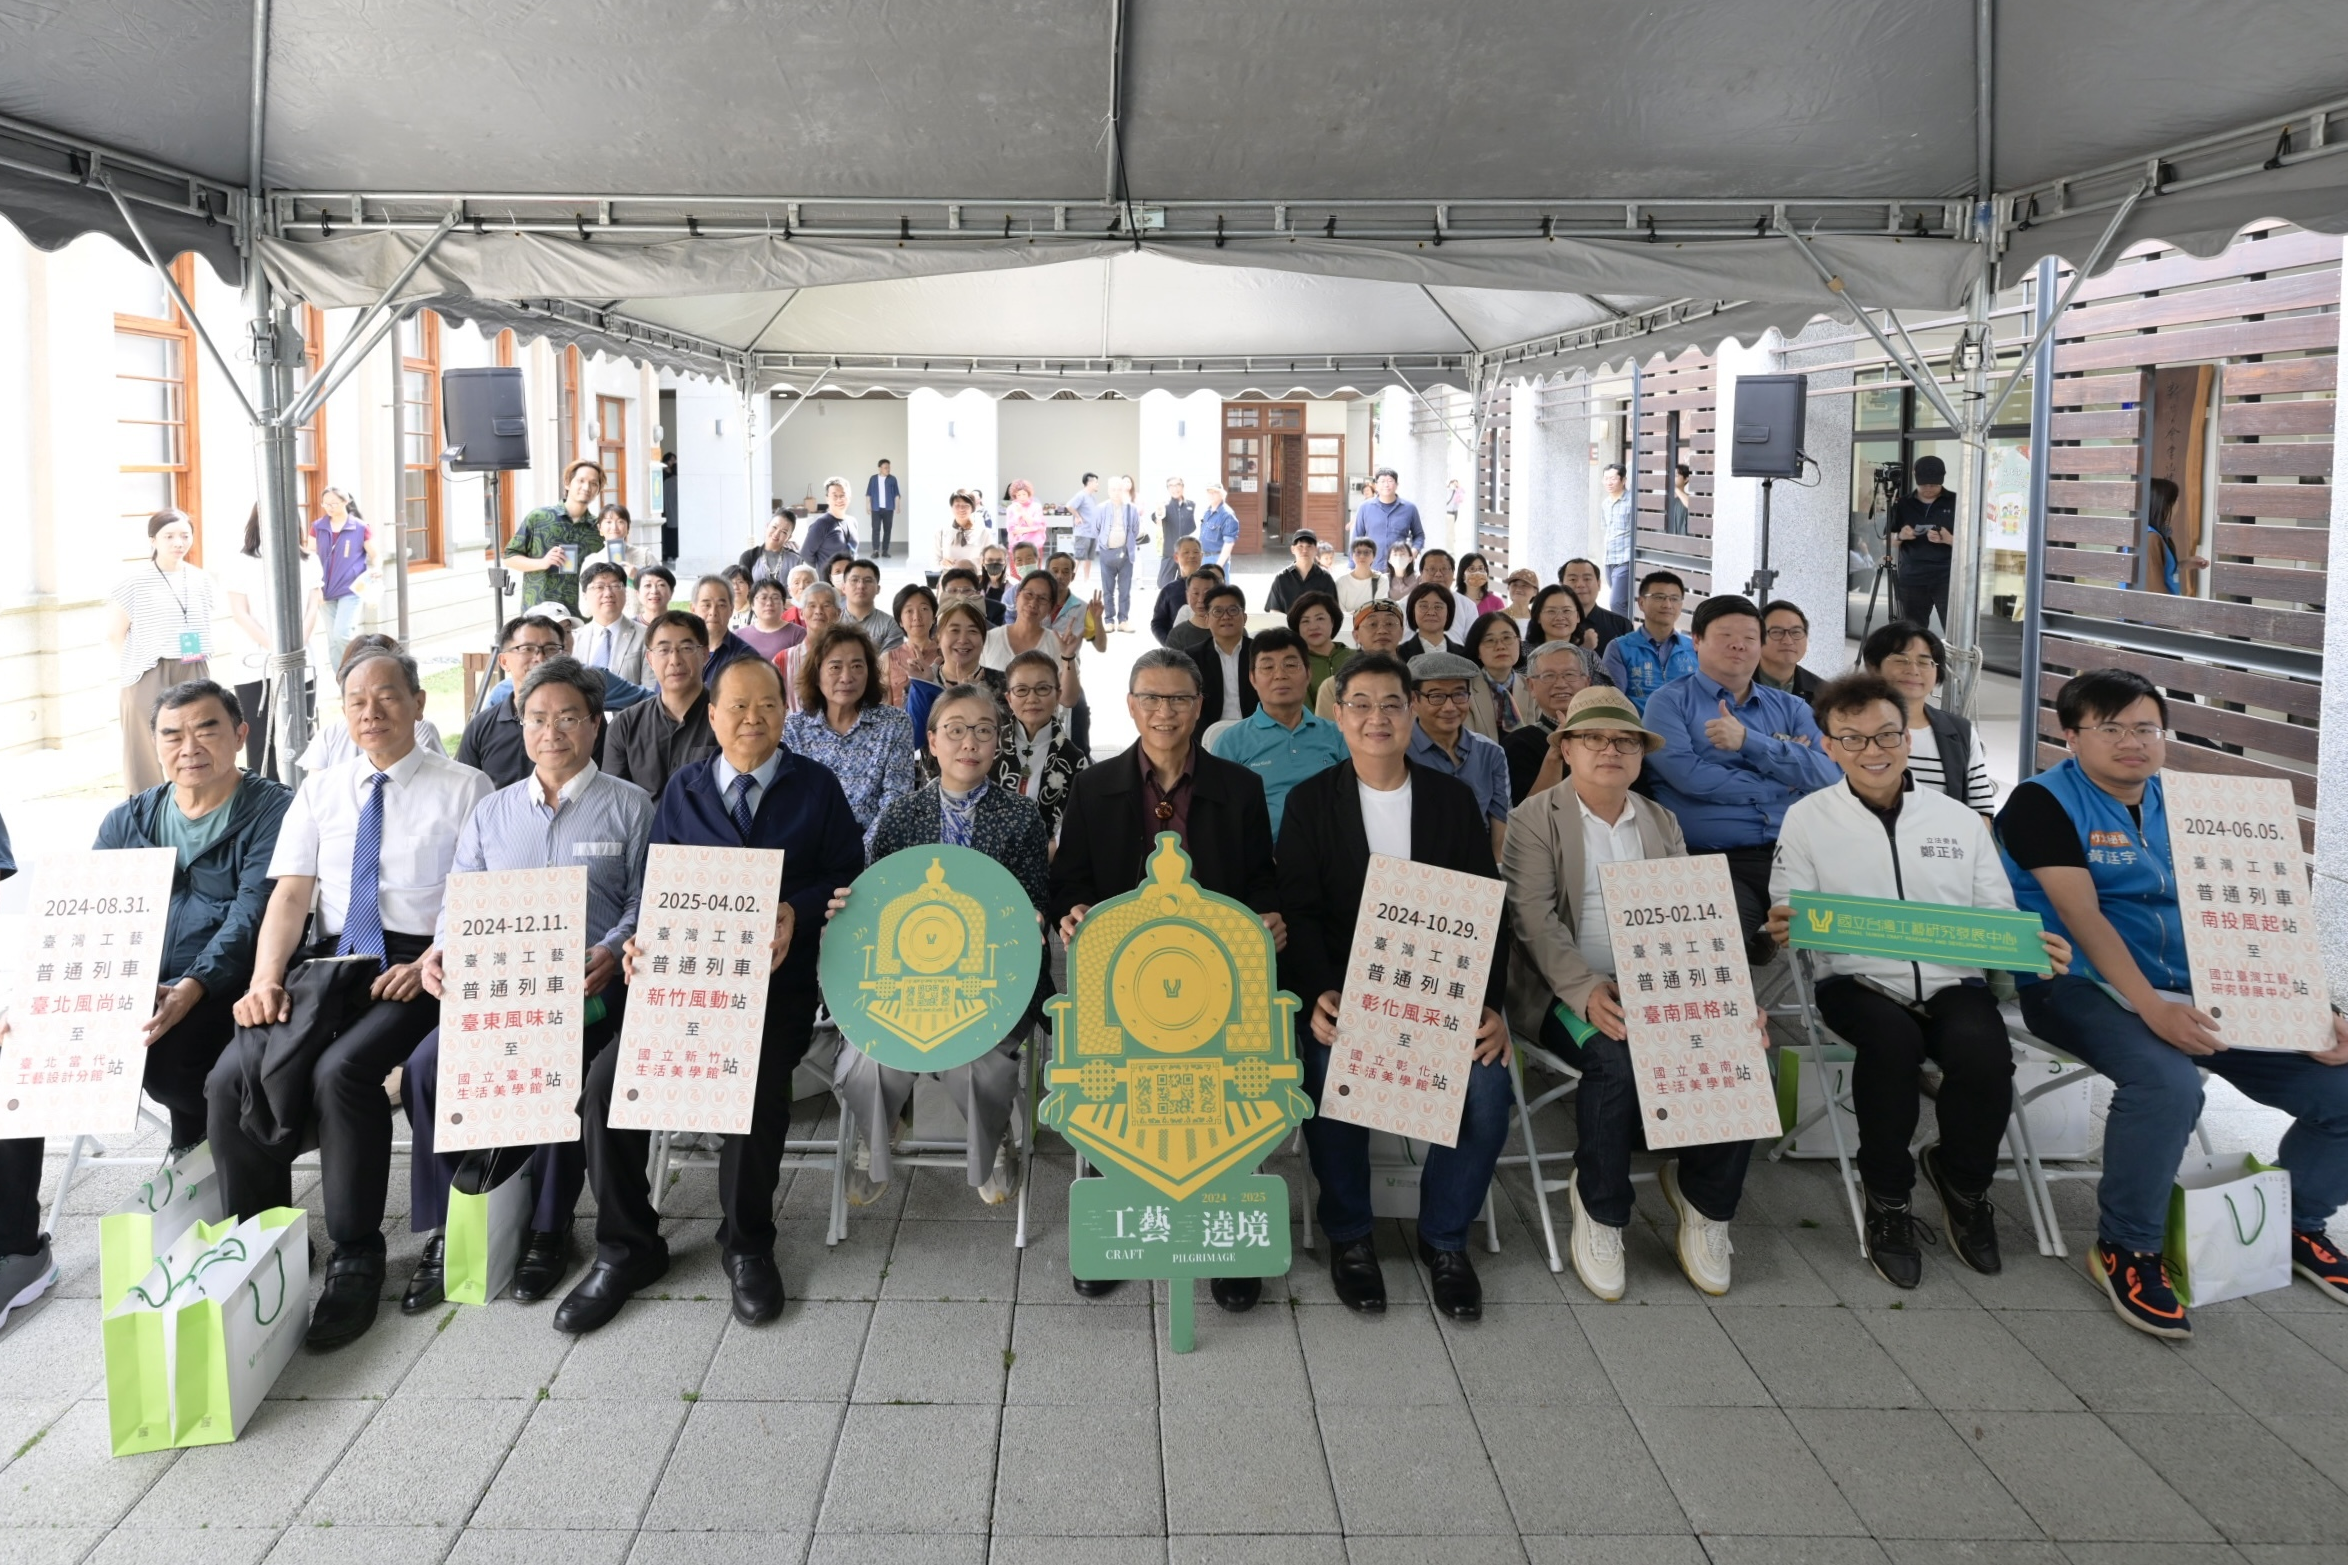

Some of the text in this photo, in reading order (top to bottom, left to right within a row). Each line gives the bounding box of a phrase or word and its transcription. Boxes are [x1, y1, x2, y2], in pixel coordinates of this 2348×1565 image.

[2185, 818, 2284, 841] 2024-06.05.
[658, 892, 761, 913] 2025-04.02.
[2197, 883, 2293, 906] 普通列車
[44, 896, 150, 917] 2024-08.31.
[1623, 904, 1723, 927] 2025-02.14.
[462, 914, 568, 936] 2024-12.11.
[1377, 903, 1478, 940] 2024-10.29.
[42, 931, 143, 949] 臺灣工藝
[657, 926, 755, 944] 臺灣工藝
[464, 948, 565, 968] 臺灣工藝
[1374, 936, 1472, 970] 臺灣工藝
[1633, 938, 1725, 959] 臺灣工藝
[2247, 944, 2261, 957] 至
[36, 959, 139, 982] 普通列車
[651, 955, 752, 977] 普通列車
[462, 975, 565, 1000] 普通列車
[1368, 963, 1466, 1000] 普通列車
[1637, 966, 1733, 992] 普通列車
[69, 1027, 84, 1042] 至
[685, 1022, 700, 1036] 至
[504, 1042, 518, 1056] 至
[1397, 1033, 1412, 1048] 至
[1690, 1035, 1704, 1049] 至
[638, 1048, 721, 1064] 國立新竹
[1350, 1048, 1431, 1078] 國立彰化
[458, 1067, 543, 1085] 國立臺東
[635, 1063, 720, 1080] 生活美學館
[1347, 1063, 1429, 1092] 生活美學館
[1653, 1060, 1732, 1079] 國立臺南
[457, 1082, 543, 1100] 生活美學館
[1656, 1075, 1736, 1095] 生活美學館
[1201, 1192, 1227, 1203] 2024
[1241, 1191, 1266, 1203] 2025
[1105, 1249, 1236, 1263] CRAFT PILGRIMAGE
